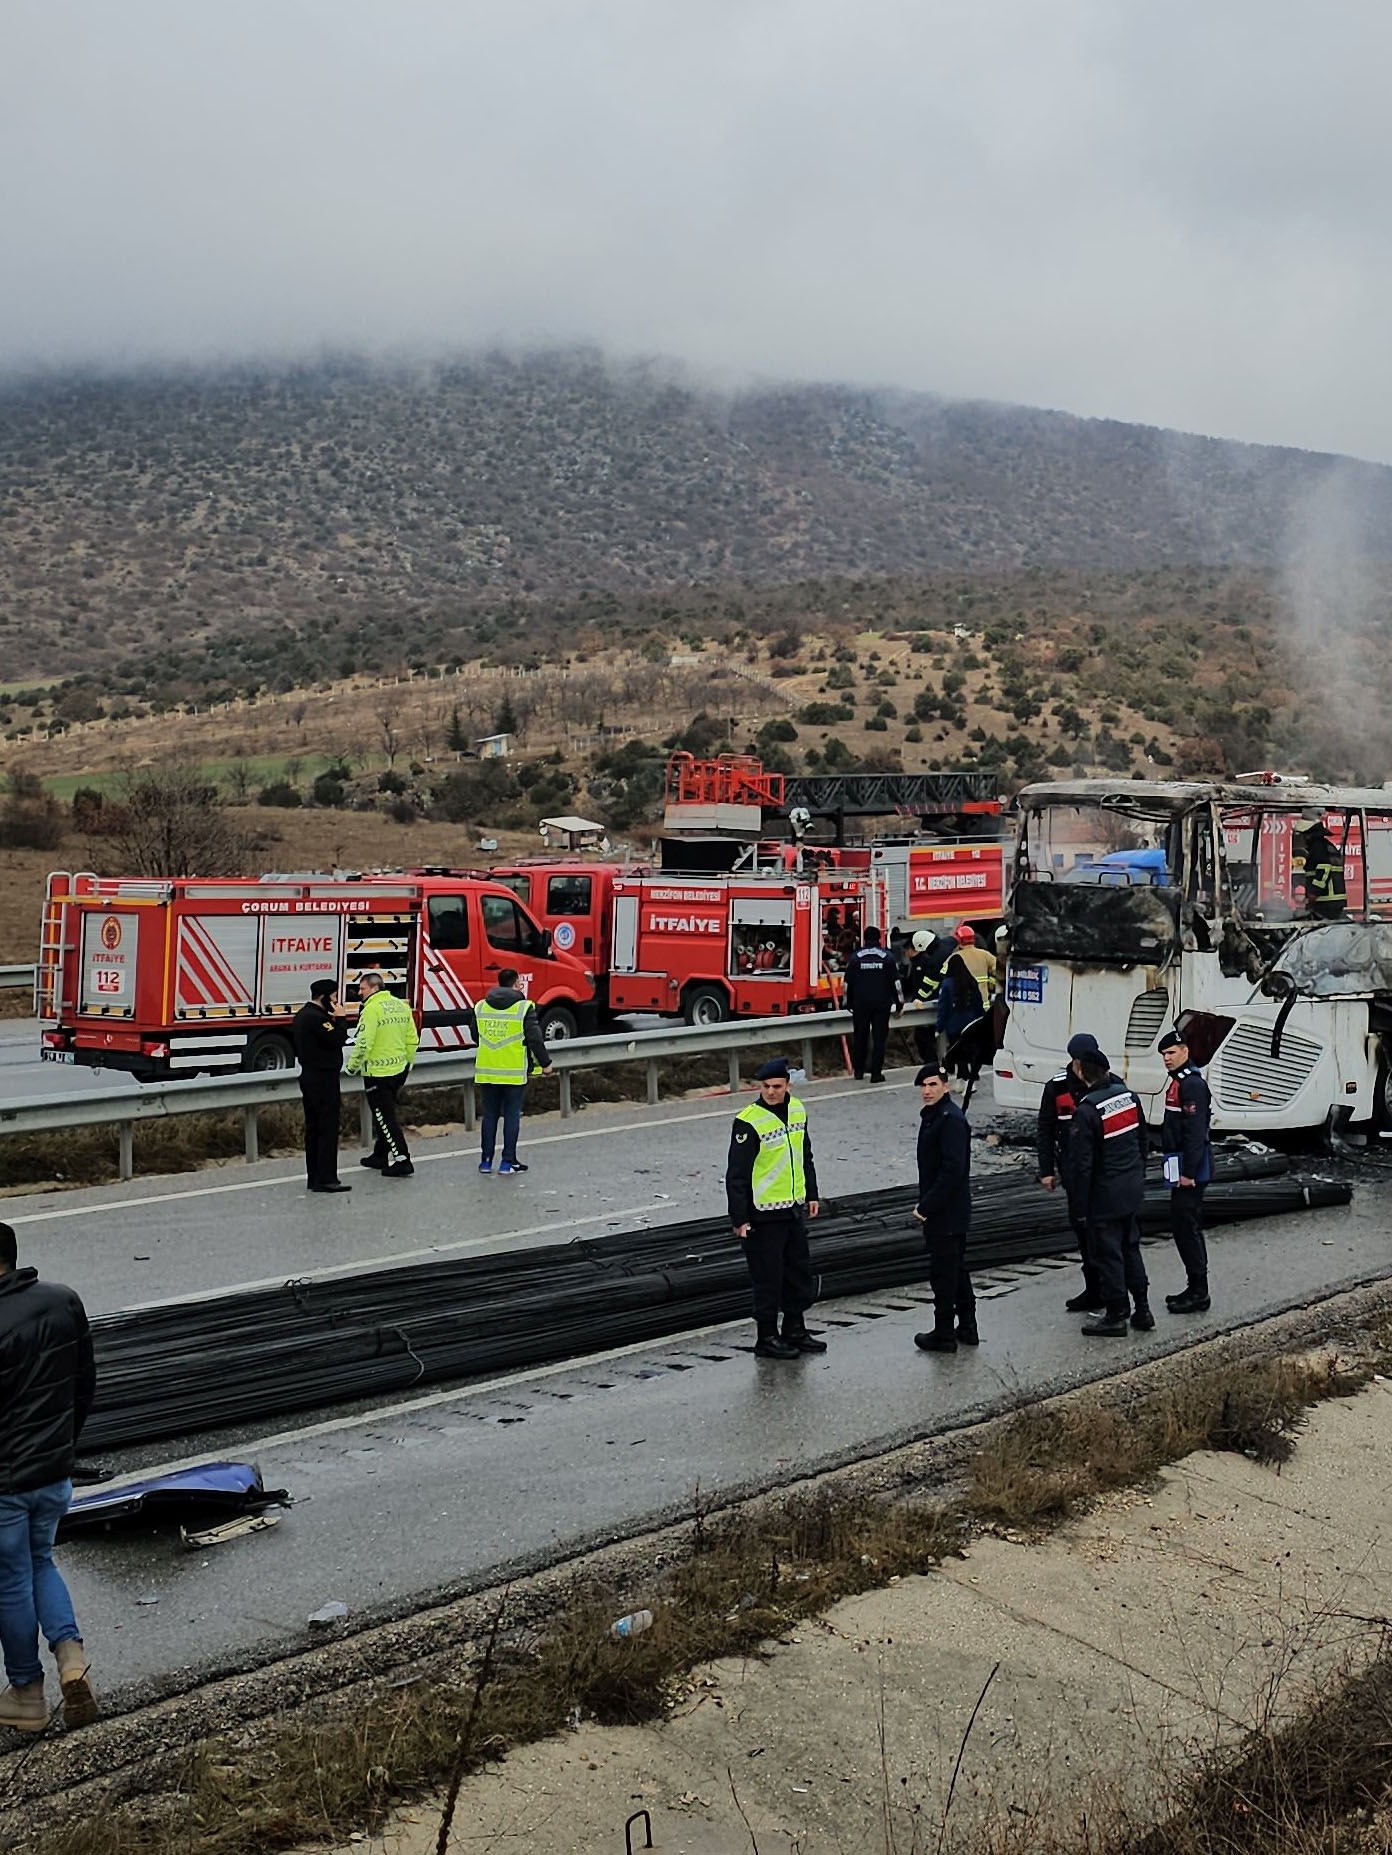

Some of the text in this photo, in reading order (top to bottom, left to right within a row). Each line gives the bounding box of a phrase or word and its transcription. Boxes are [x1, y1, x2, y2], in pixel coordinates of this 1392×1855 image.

[241, 901, 370, 914] ÇORUM BELEDİYESİ
[649, 914, 720, 933] İTFAİYE
[271, 937, 333, 953] İTFAİYE
[92, 952, 125, 963] İTFAİYE
[96, 970, 120, 984] 112
